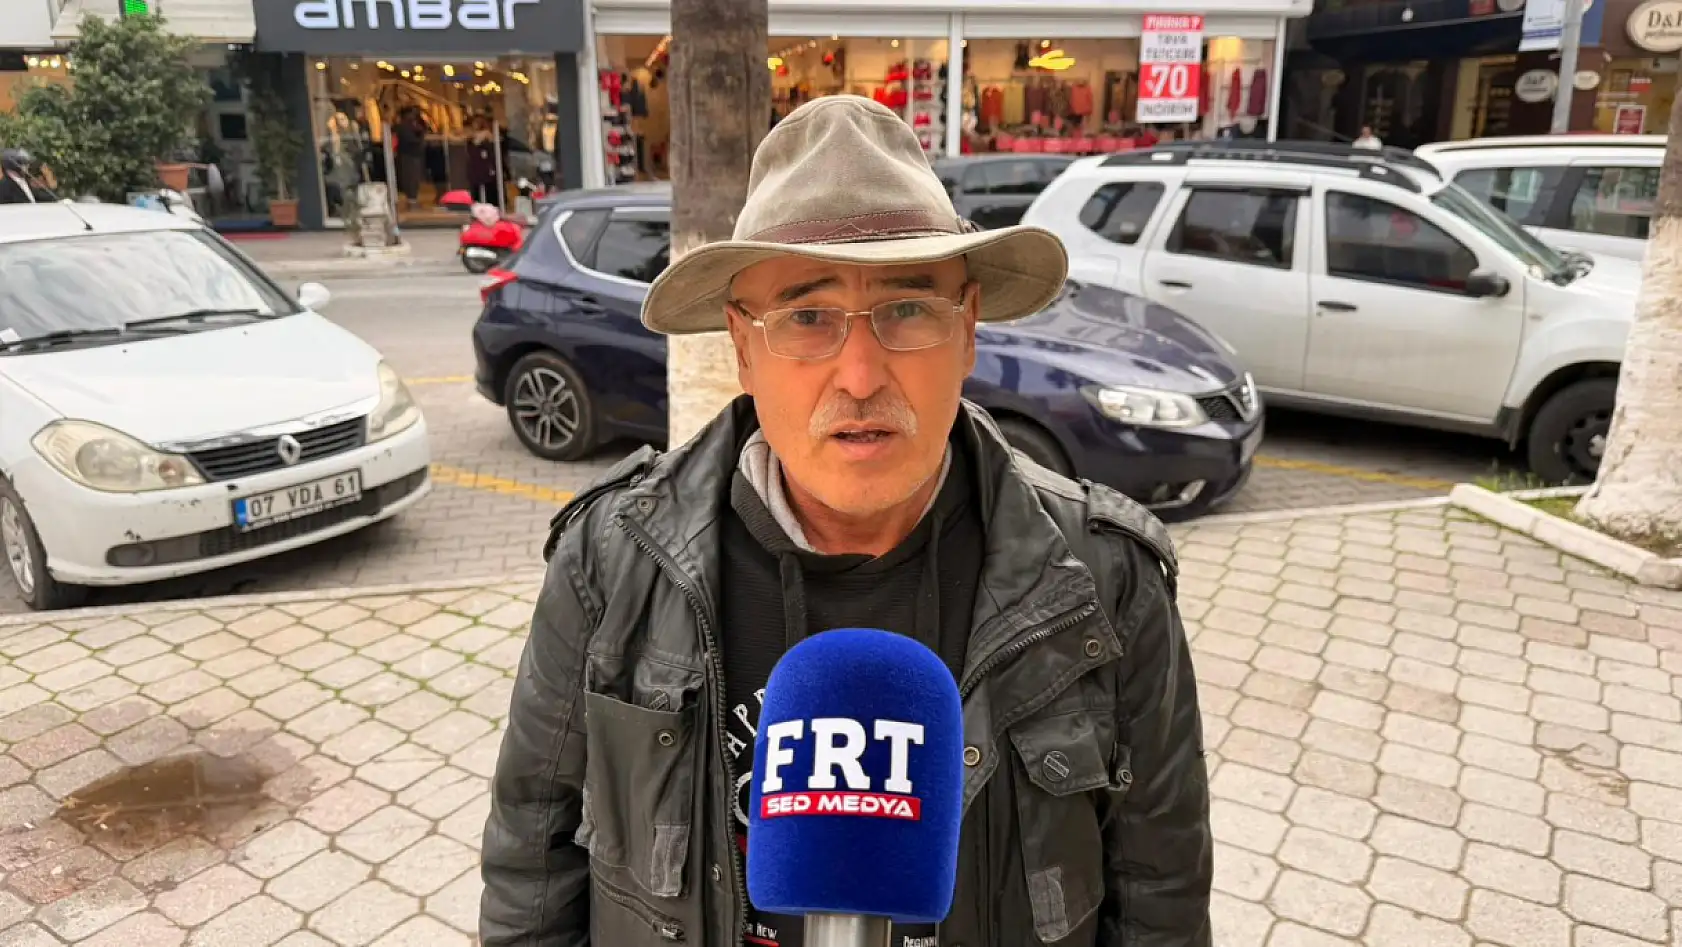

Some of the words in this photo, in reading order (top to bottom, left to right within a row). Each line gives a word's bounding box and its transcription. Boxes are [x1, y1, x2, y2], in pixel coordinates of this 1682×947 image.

[251, 496, 274, 517] 07
[335, 475, 356, 495] 61
[761, 717, 925, 794] FRT
[767, 795, 812, 814] SED
[817, 794, 914, 818] MEDYA
